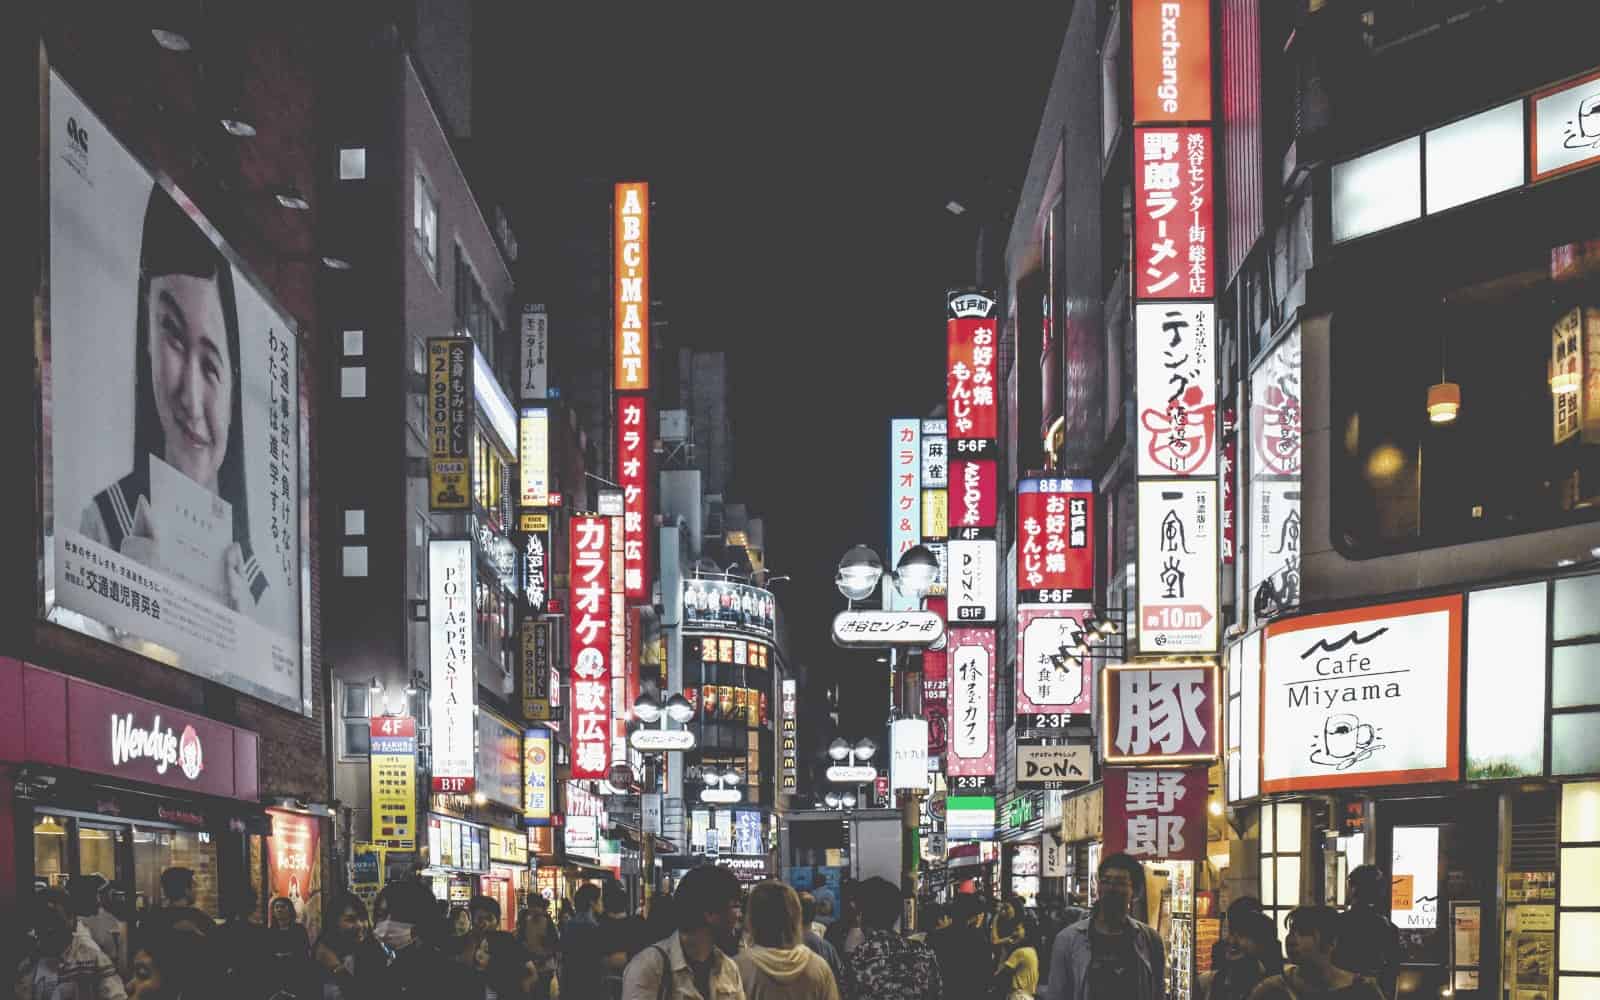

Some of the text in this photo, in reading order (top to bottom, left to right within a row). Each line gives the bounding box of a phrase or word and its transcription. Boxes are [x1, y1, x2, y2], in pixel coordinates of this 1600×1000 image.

[1158, 3, 1180, 113] Exchange
[1143, 132, 1180, 294] 野郎ラーメン
[951, 361, 973, 433] もんじゃ
[972, 327, 993, 405] お好み焼
[928, 443, 944, 479] 麻雀
[622, 404, 643, 591] カラオケ歌広場
[963, 528, 979, 540] 4F
[1023, 517, 1043, 586] もんじゃ
[1045, 495, 1066, 574] お好み焼
[1161, 490, 1196, 599] 一風堂
[86, 569, 161, 620] 交通遺児育英会
[840, 619, 937, 632] 渋谷センター街
[961, 608, 982, 618] B1F
[575, 518, 607, 773] カラオケの歌広場
[1037, 652, 1053, 699] お食事
[1315, 653, 1372, 677] Cafe
[1115, 671, 1207, 756] 豚
[1288, 680, 1402, 709] Miyama
[111, 713, 178, 775] Wendy's
[381, 719, 402, 735] 4F
[442, 778, 466, 791] B1F
[1025, 758, 1083, 777] DONA
[1124, 771, 1187, 858] 野郎
